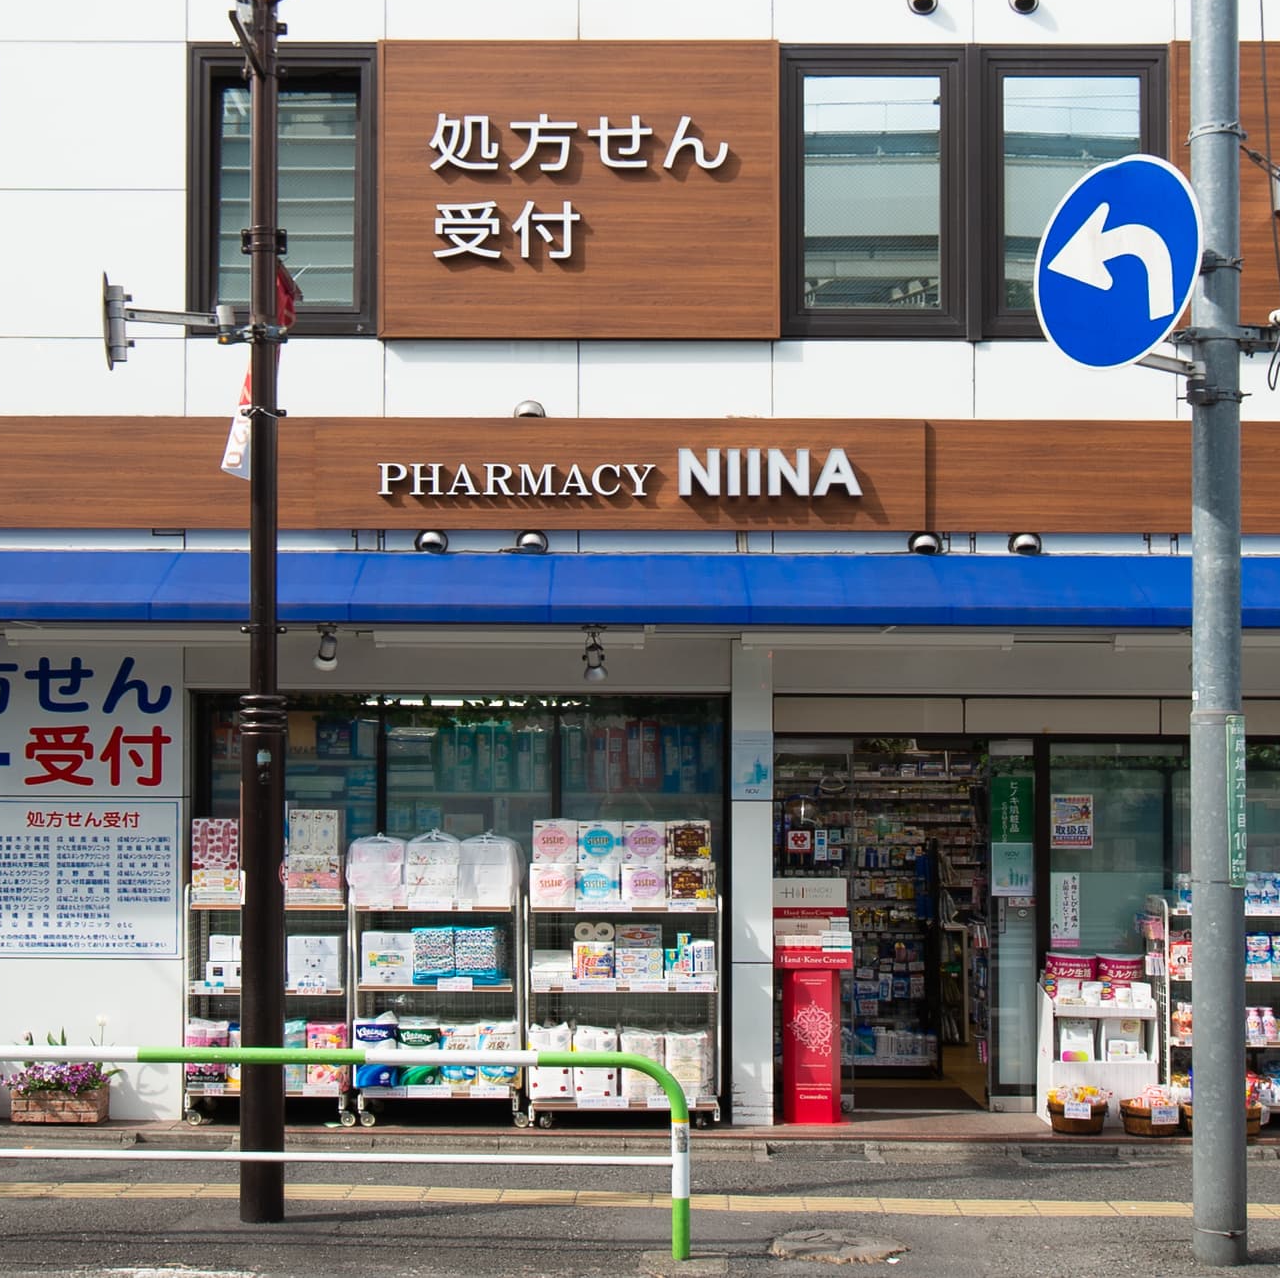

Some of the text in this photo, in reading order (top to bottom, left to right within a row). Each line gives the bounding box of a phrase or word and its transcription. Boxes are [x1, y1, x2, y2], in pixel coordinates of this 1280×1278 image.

[429, 113, 728, 171] 処方せん
[432, 201, 580, 259] 受付
[377, 448, 863, 497] PHARMACY NIINA
[24, 725, 172, 786] 受付
[26, 811, 141, 828] 処方せん受付
[823, 955, 847, 963] Cream
